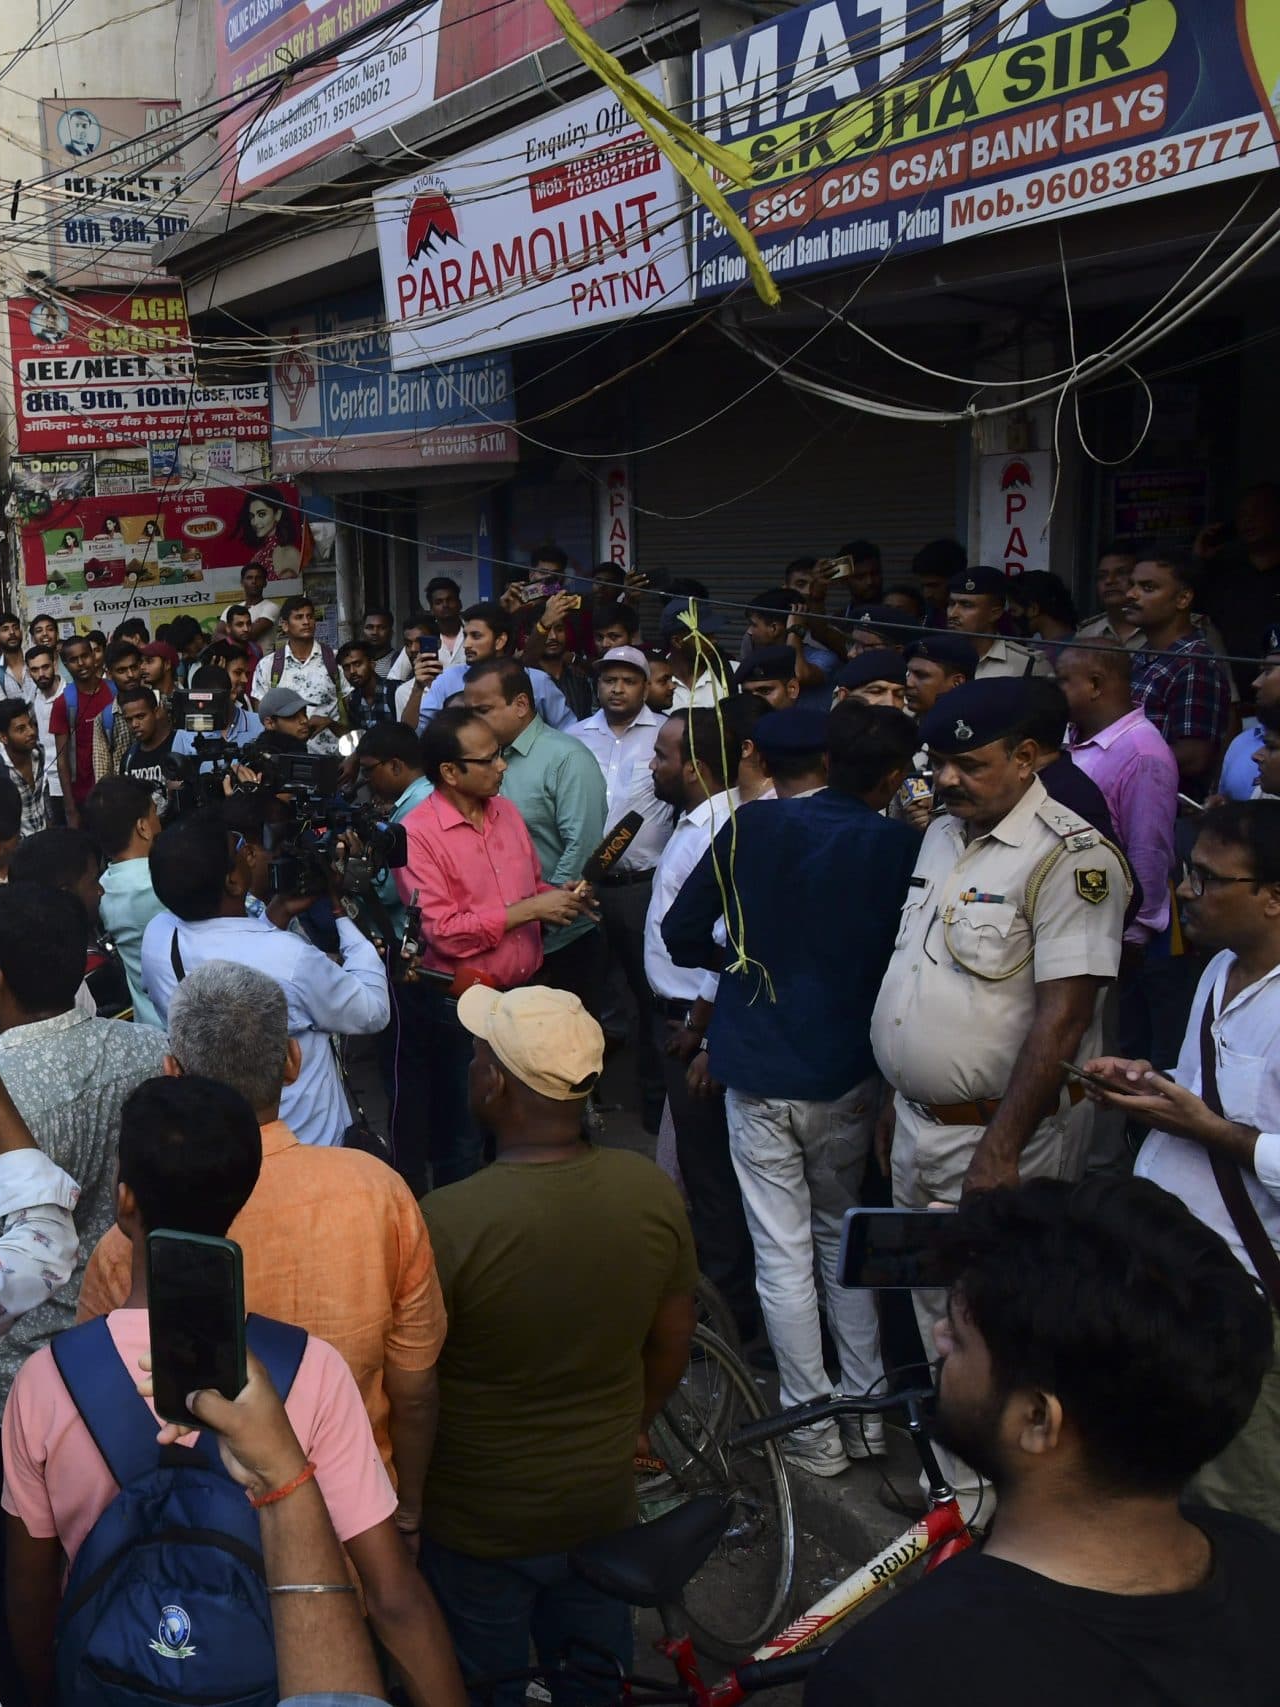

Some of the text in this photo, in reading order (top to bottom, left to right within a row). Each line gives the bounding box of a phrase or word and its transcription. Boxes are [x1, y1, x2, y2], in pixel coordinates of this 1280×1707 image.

[337, 5, 353, 34] 1st
[323, 87, 336, 105] 1st
[337, 73, 360, 93] Floor,
[362, 62, 386, 84] Naya
[387, 45, 407, 69] Tola
[856, 69, 979, 151] JHA
[1003, 15, 1131, 103] SIR
[279, 115, 331, 153] 9608383777,
[333, 78, 390, 124] 9576090672
[526, 122, 588, 164] Enquiry
[753, 83, 1165, 227] SSC CDS CSAT BANK RLYS
[535, 152, 655, 200] Mob. 7033027777
[397, 191, 657, 320] PARAMOUNT
[702, 206, 940, 289] 1st Floor entral Bank Building, Patna
[570, 262, 666, 316] PATNA
[81, 390, 129, 411] 9th,
[136, 387, 187, 408] 10th
[232, 388, 260, 402] ICSE
[328, 359, 507, 422] Central Bank of India
[67, 434, 103, 446] Mob.:
[121, 415, 141, 428] बैंक
[144, 414, 158, 427] के
[436, 434, 477, 456] HOURS
[480, 431, 507, 453] ATM
[30, 460, 80, 474] Dance
[93, 600, 130, 613] विजय
[181, 591, 211, 603] स्टोर
